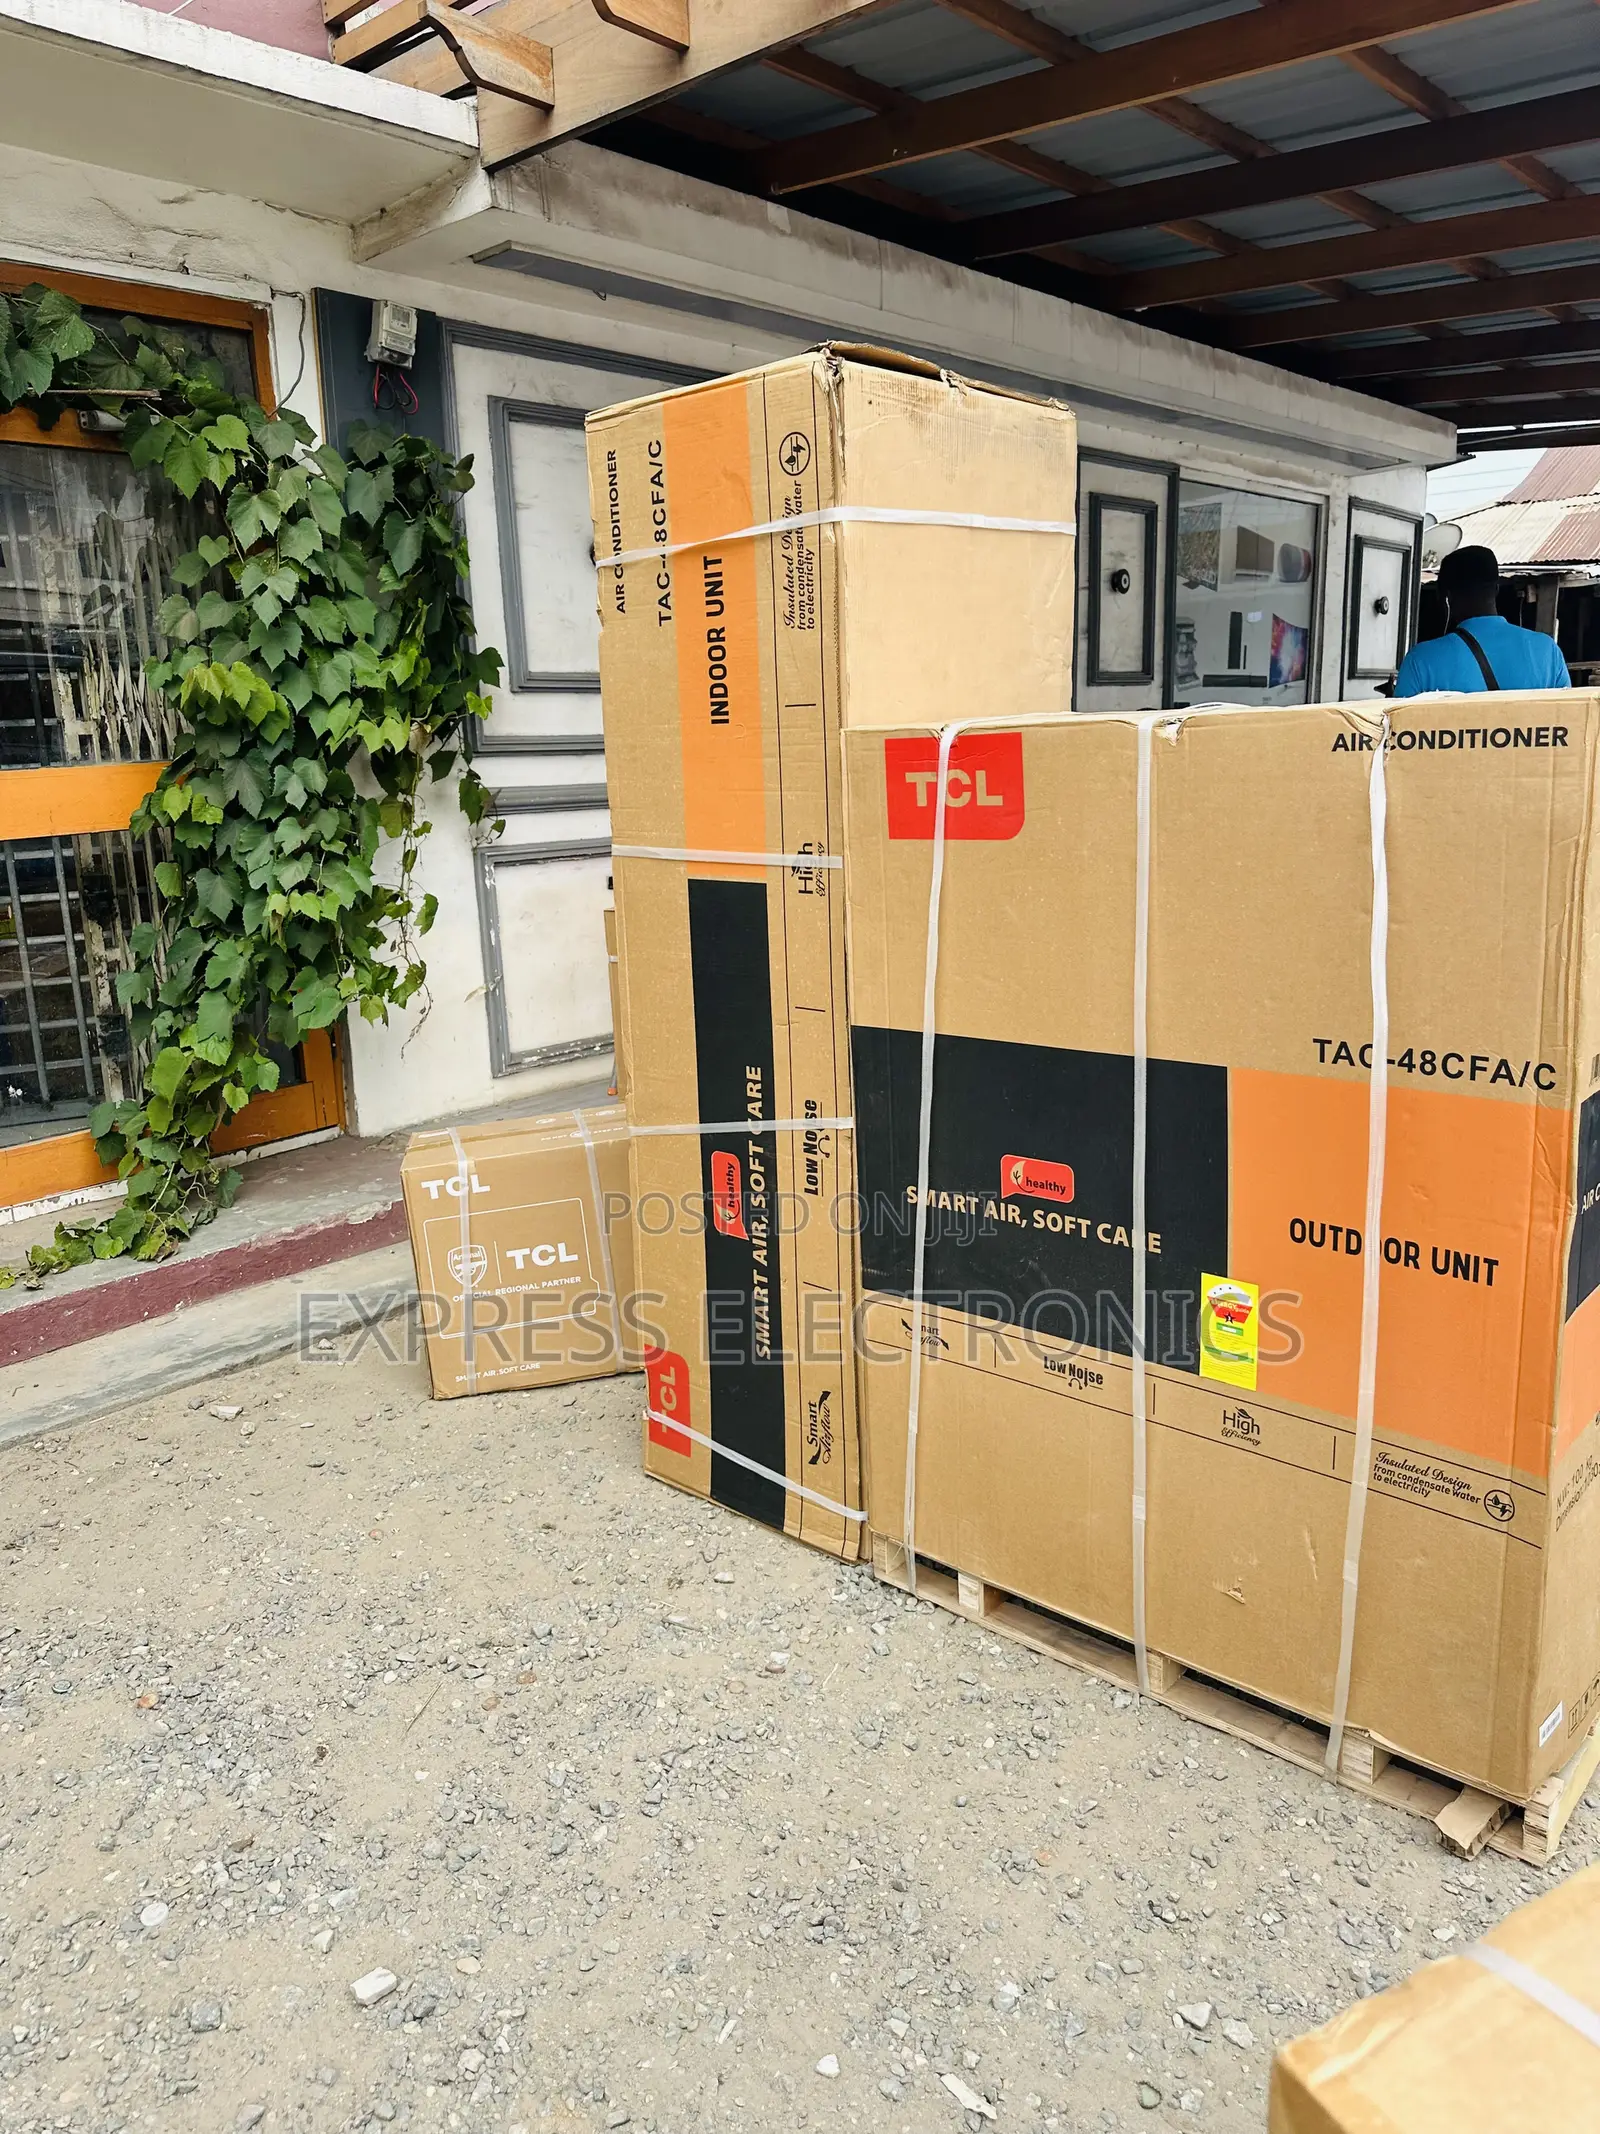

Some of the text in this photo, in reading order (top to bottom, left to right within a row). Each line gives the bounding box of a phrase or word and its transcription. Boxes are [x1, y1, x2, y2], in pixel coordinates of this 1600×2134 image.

[648, 439, 673, 627] TAC-8CFA/C
[781, 495, 795, 629] Insulated Deign
[616, 583, 626, 614] AIR
[806, 548, 815, 630] to electricity
[797, 599, 806, 631] from
[703, 556, 730, 725] INDOOR UNIT
[1331, 726, 1570, 752] AIR CONDITIONER
[905, 768, 1004, 808] TCL
[815, 842, 826, 897] Efficcy
[802, 1099, 820, 1196] Low Nose
[421, 1174, 491, 1200] TCL
[727, 1161, 736, 1208] healthy
[748, 1140, 766, 1208] SOFT
[1026, 1175, 1067, 1195] healthy
[1581, 1190, 1594, 1215] AIR
[984, 1199, 1028, 1229] AIR,
[1033, 1209, 1092, 1239] SOFT
[1096, 1223, 1162, 1255] CAE
[453, 1251, 483, 1262] Arnal
[505, 1242, 579, 1270] TCL
[1289, 1217, 1500, 1287] OUTDOR UNIT
[452, 1276, 582, 1303] OFCIAL REGIONAL PARTNER
[753, 1268, 772, 1361] SMART
[918, 1323, 940, 1337] mart
[455, 1371, 481, 1383] SMT
[519, 1362, 541, 1373] CARE
[1043, 1355, 1104, 1387] Low Noise
[806, 1400, 819, 1448] Smart
[818, 1402, 835, 1465] Airflow
[1220, 1426, 1262, 1447] Efficiency
[1222, 1409, 1261, 1437] High
[1373, 1463, 1397, 1480] from
[1397, 1470, 1451, 1495] condensate
[1373, 1472, 1432, 1498] to electricity
[1375, 1451, 1473, 1492] Insulated Design
